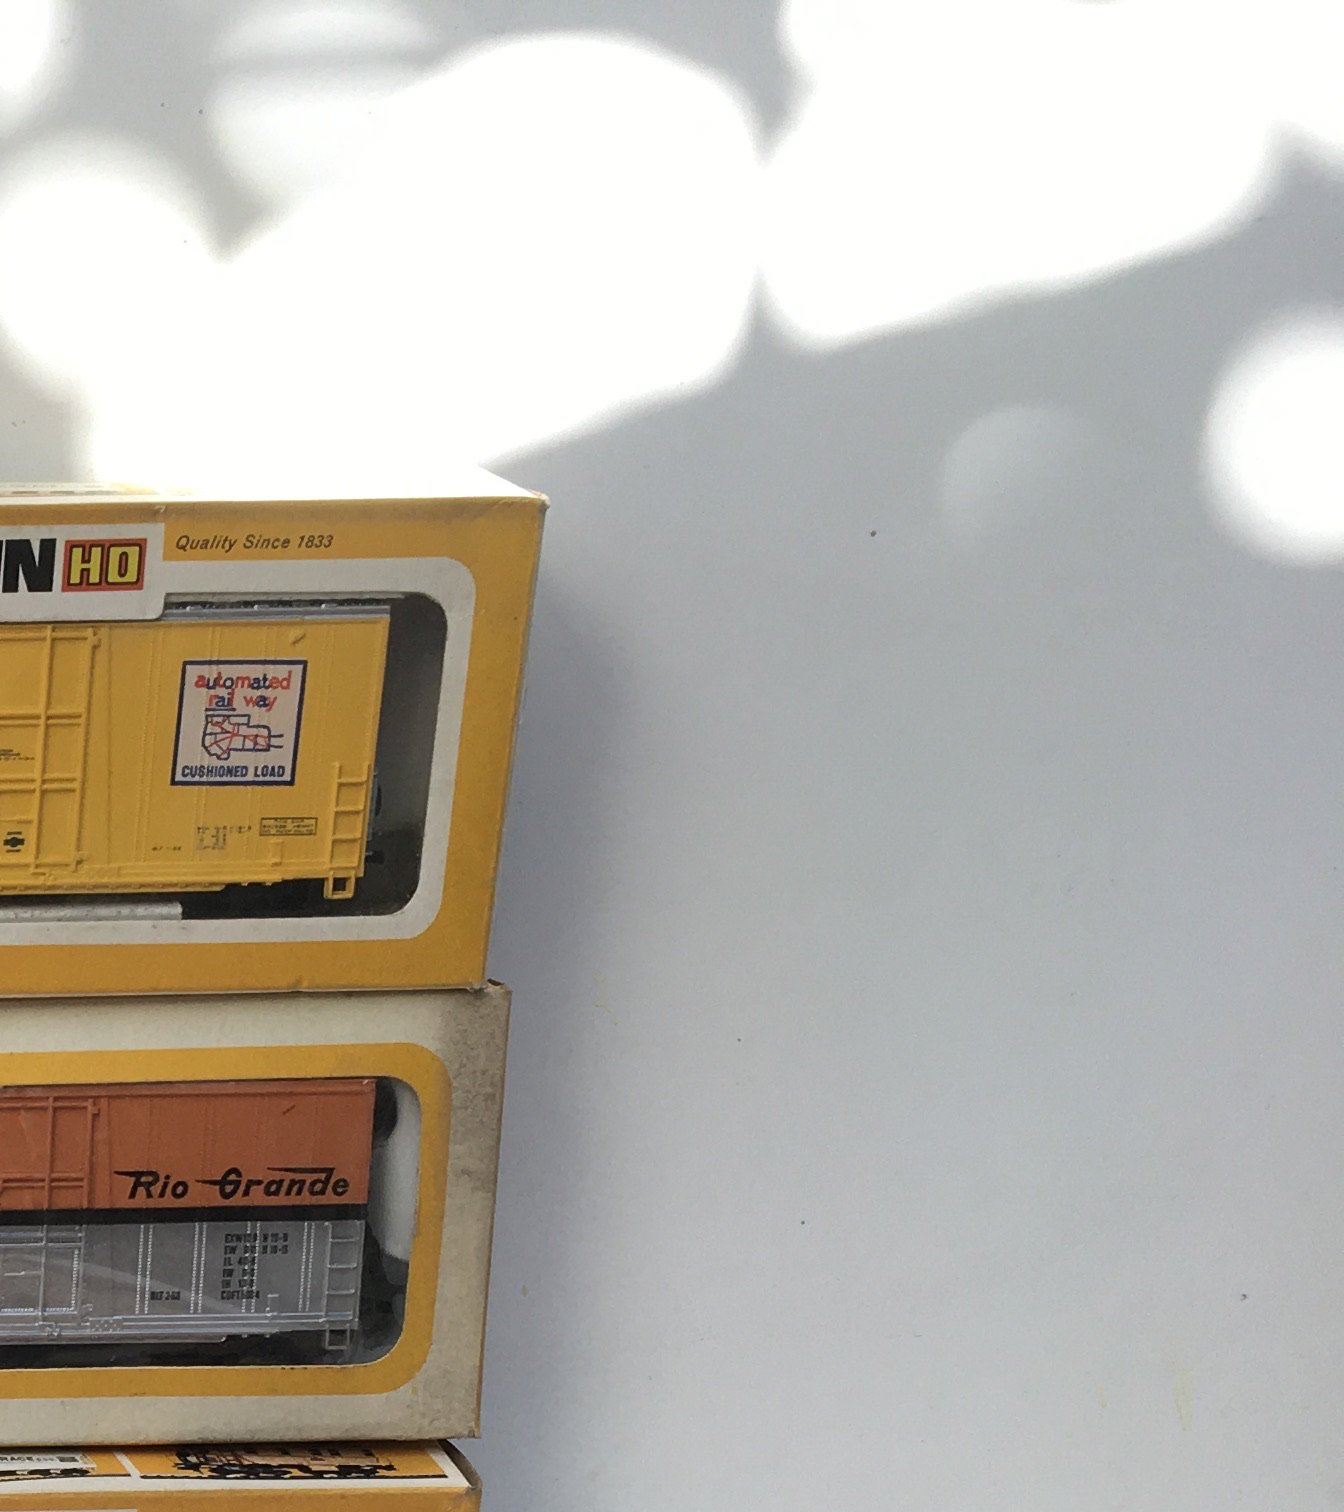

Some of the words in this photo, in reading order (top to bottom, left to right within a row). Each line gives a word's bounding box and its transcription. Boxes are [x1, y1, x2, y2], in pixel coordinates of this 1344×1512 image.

[174, 533, 237, 553] Quality
[243, 533, 291, 550] Since
[297, 533, 334, 549] 1833
[69, 544, 143, 588] HO
[194, 671, 292, 691] automated
[208, 688, 236, 708] rail
[243, 694, 278, 712] way
[181, 765, 249, 778] CUSHIONED
[253, 765, 286, 778] LOAD
[114, 1168, 190, 1200] Rio
[195, 1166, 350, 1199] Grande
